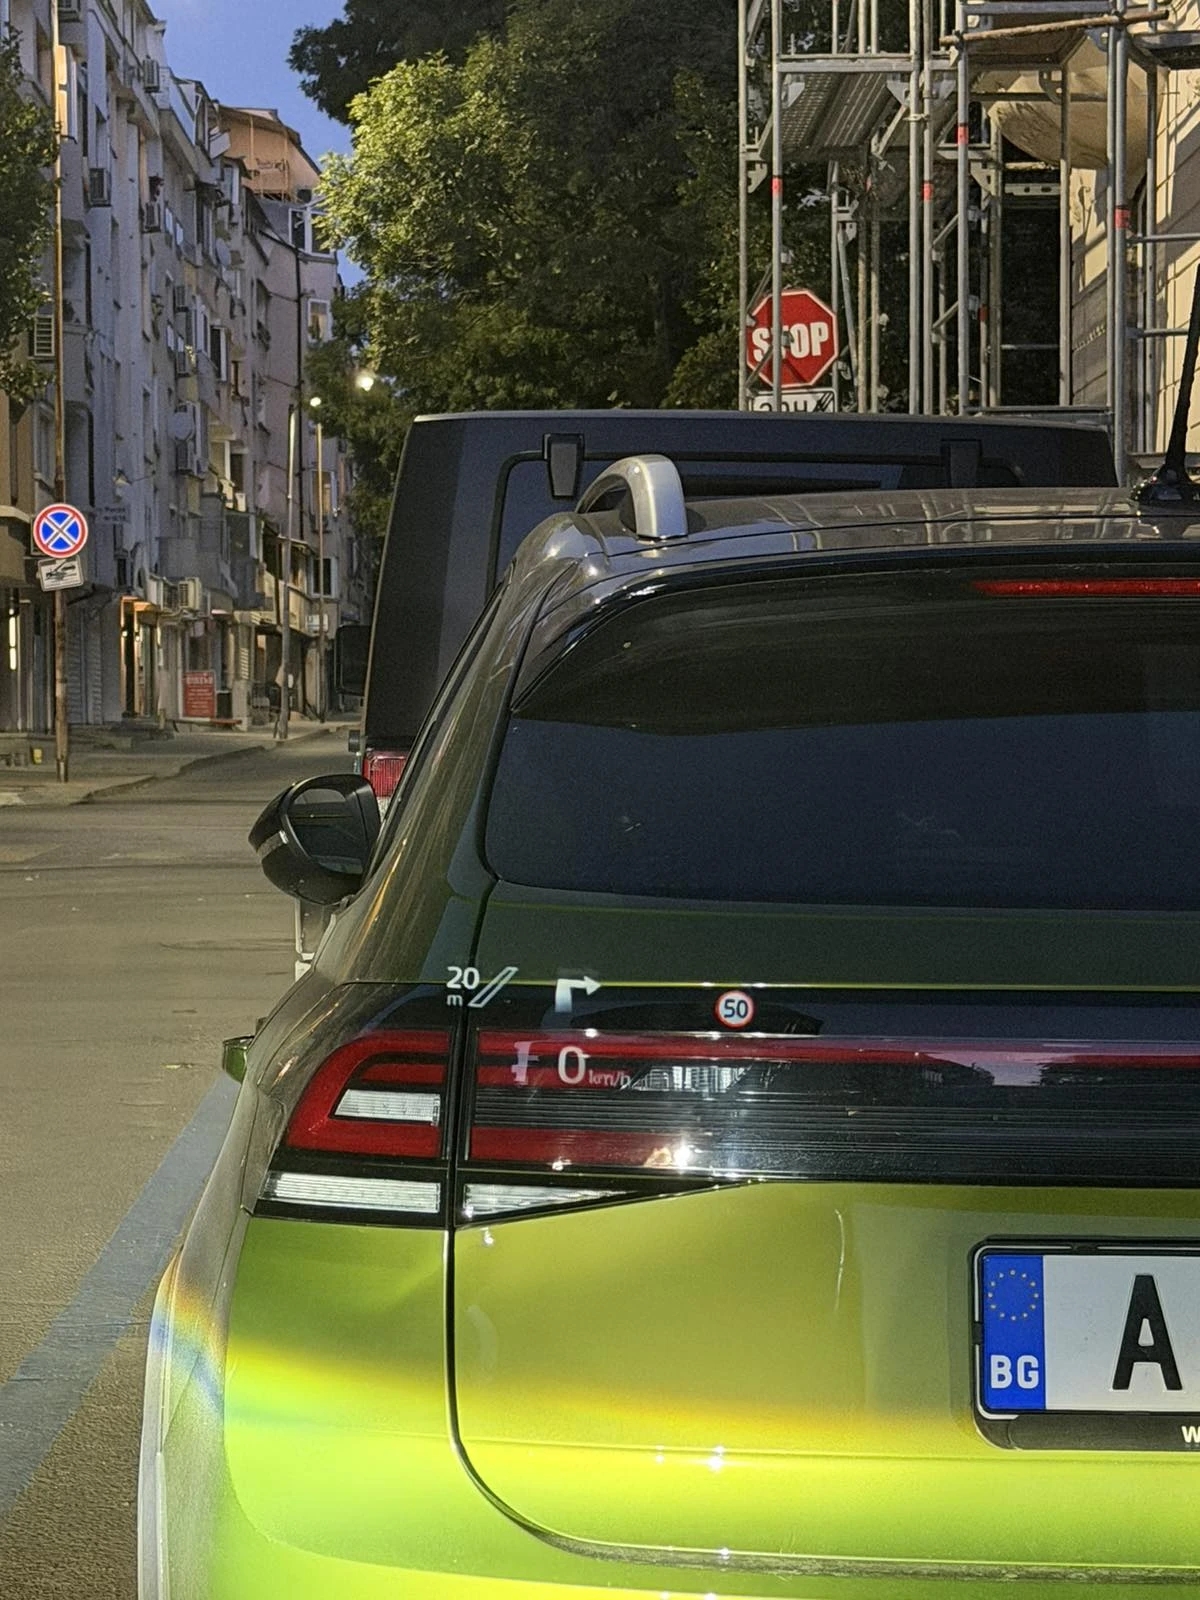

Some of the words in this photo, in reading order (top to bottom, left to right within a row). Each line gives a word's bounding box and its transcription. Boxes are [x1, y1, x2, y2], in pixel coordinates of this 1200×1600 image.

[446, 966, 481, 990] 20
[446, 994, 463, 1007] m
[723, 999, 748, 1018] 50
[558, 1046, 587, 1085] 0
[1112, 1274, 1183, 1391] A
[990, 1354, 1039, 1389] BG
